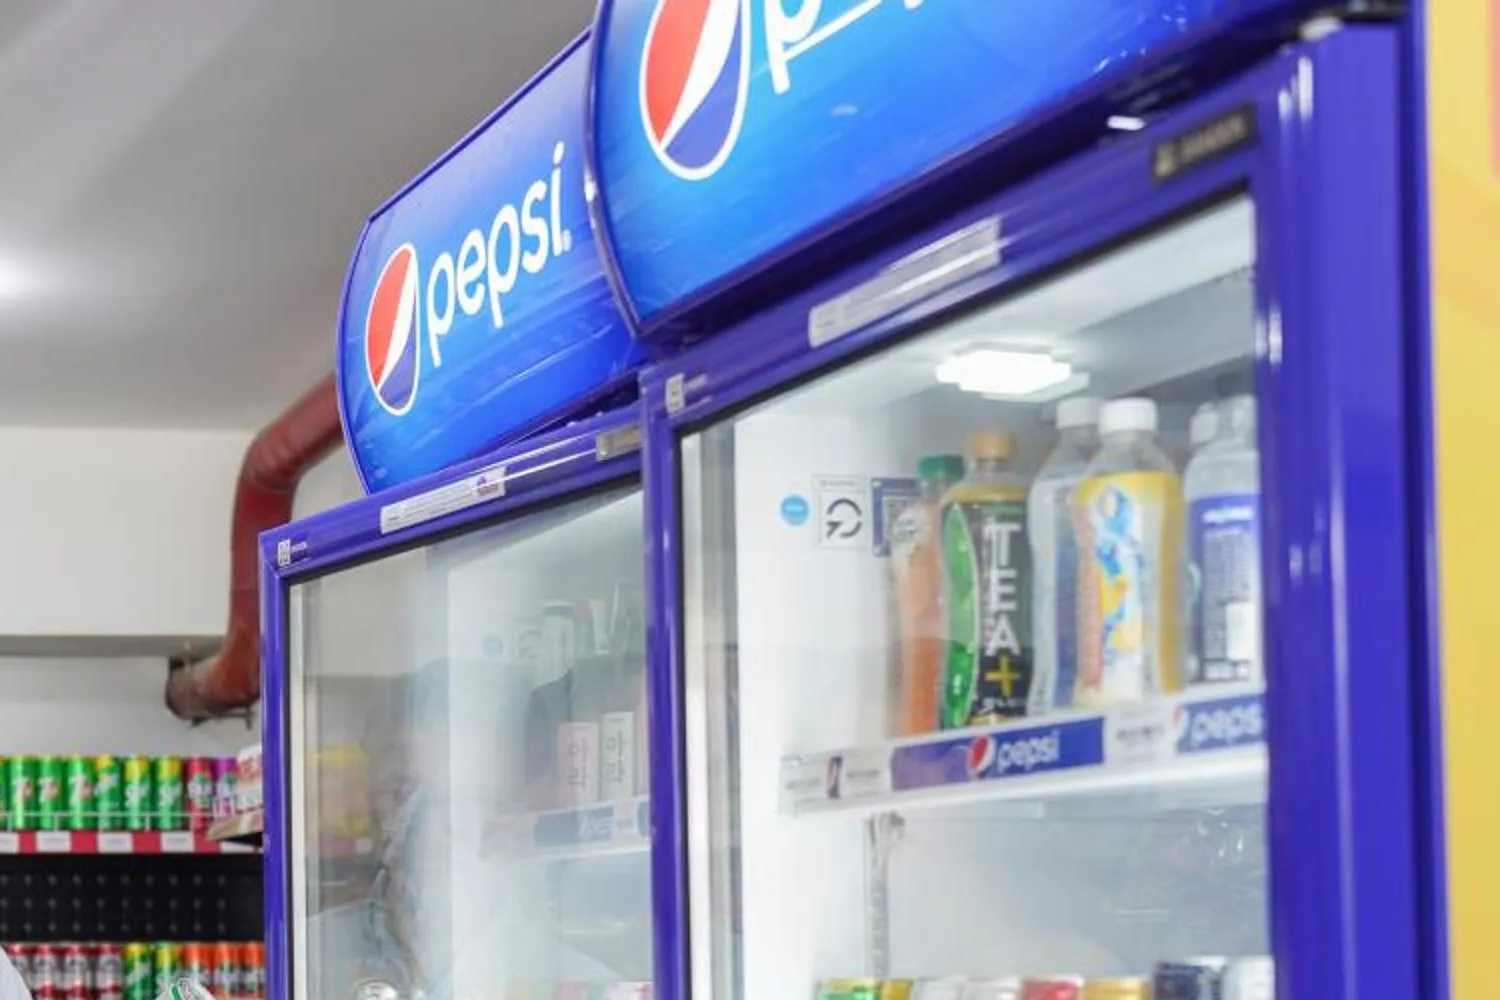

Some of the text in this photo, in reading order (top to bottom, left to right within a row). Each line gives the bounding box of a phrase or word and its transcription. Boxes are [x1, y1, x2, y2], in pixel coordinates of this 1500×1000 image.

[426, 141, 566, 367] pepsi
[1190, 701, 1264, 748] peps
[997, 729, 1061, 774] pepsi
